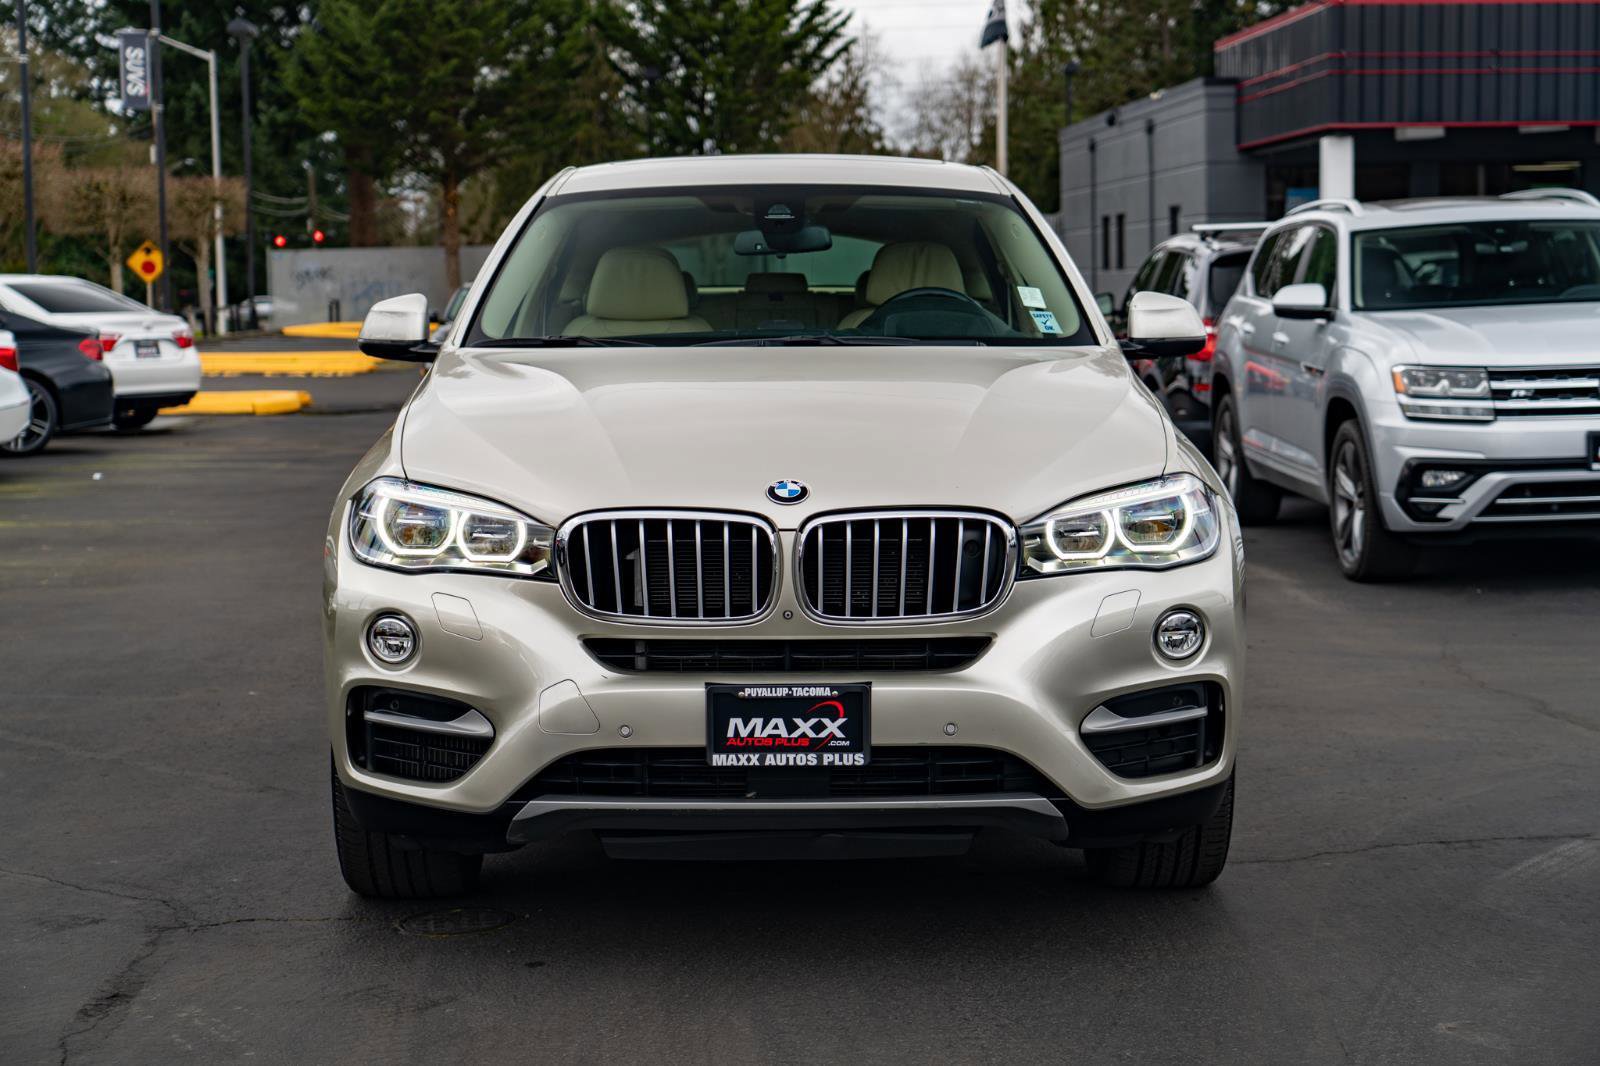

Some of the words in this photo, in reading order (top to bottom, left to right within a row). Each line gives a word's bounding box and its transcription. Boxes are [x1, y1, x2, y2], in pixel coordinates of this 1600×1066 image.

[726, 717, 848, 738] MAXX
[726, 738, 773, 746] AUTOS
[775, 738, 810, 746] PLUS
[712, 754, 760, 766] MAXX
[764, 753, 818, 766] AUTOS
[823, 753, 865, 766] PLUS
